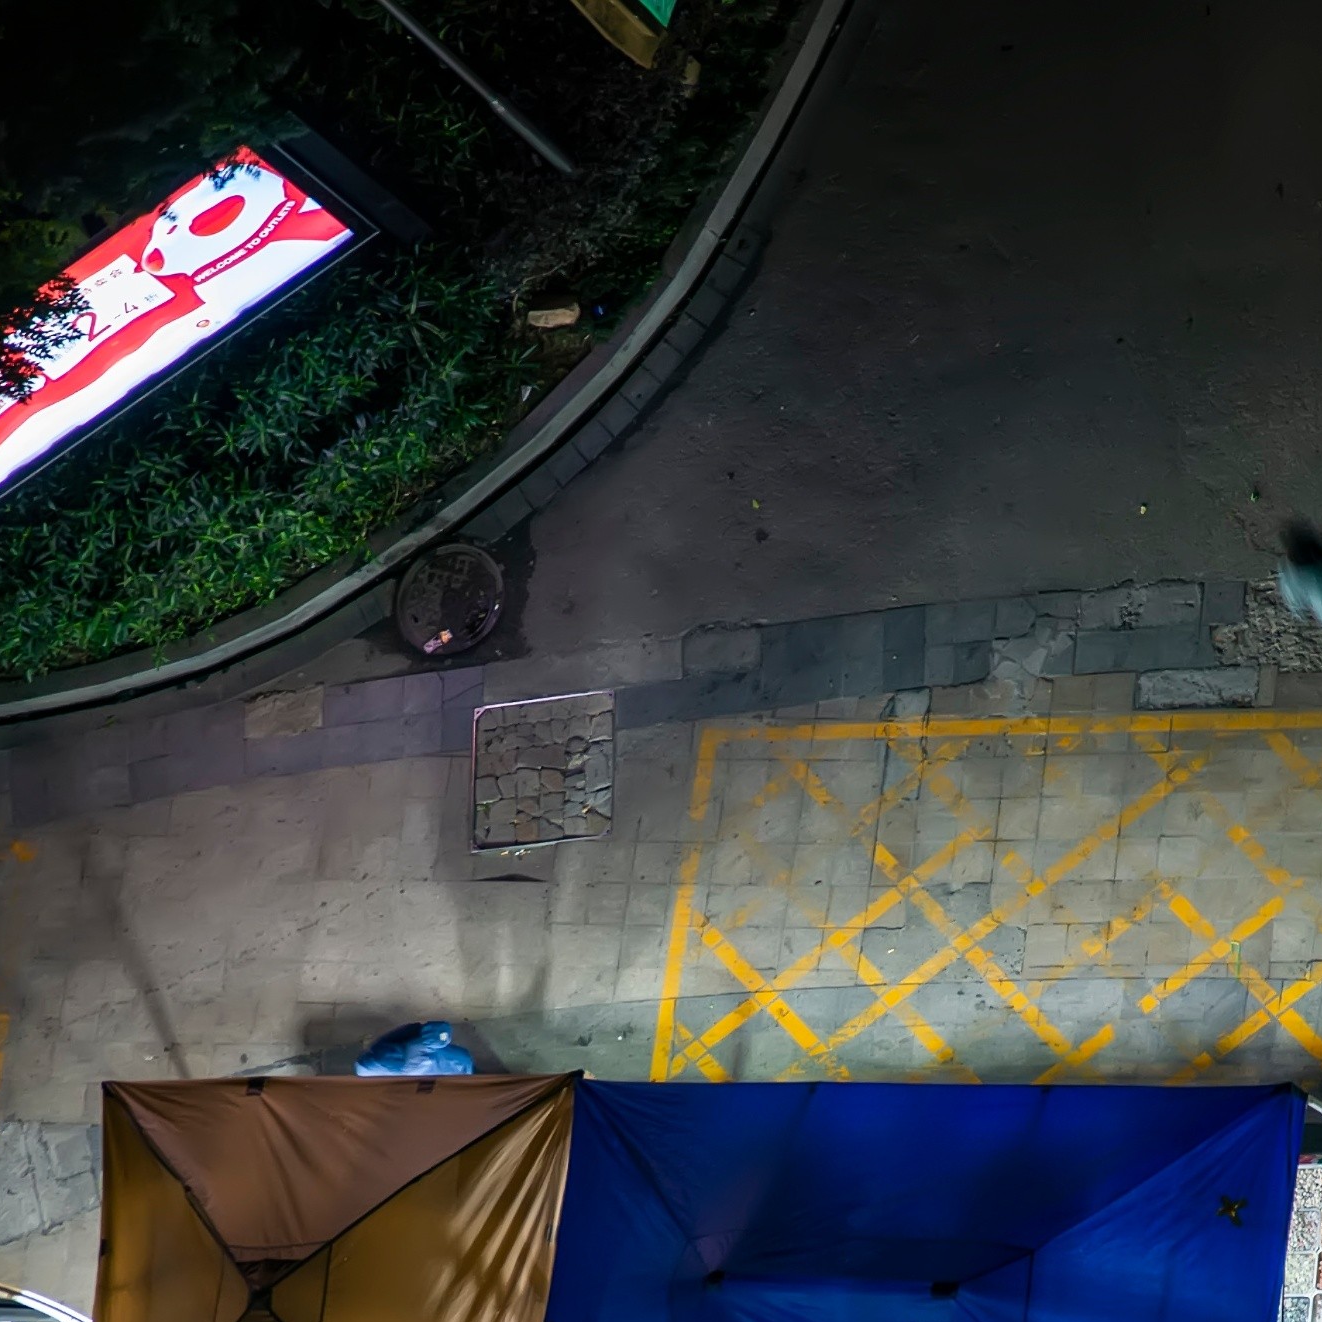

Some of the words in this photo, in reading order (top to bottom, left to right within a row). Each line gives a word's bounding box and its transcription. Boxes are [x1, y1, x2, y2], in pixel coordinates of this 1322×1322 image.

[193, 247, 248, 283] WELCOME
[245, 236, 262, 250] TO
[258, 200, 297, 239] OUTLETS
